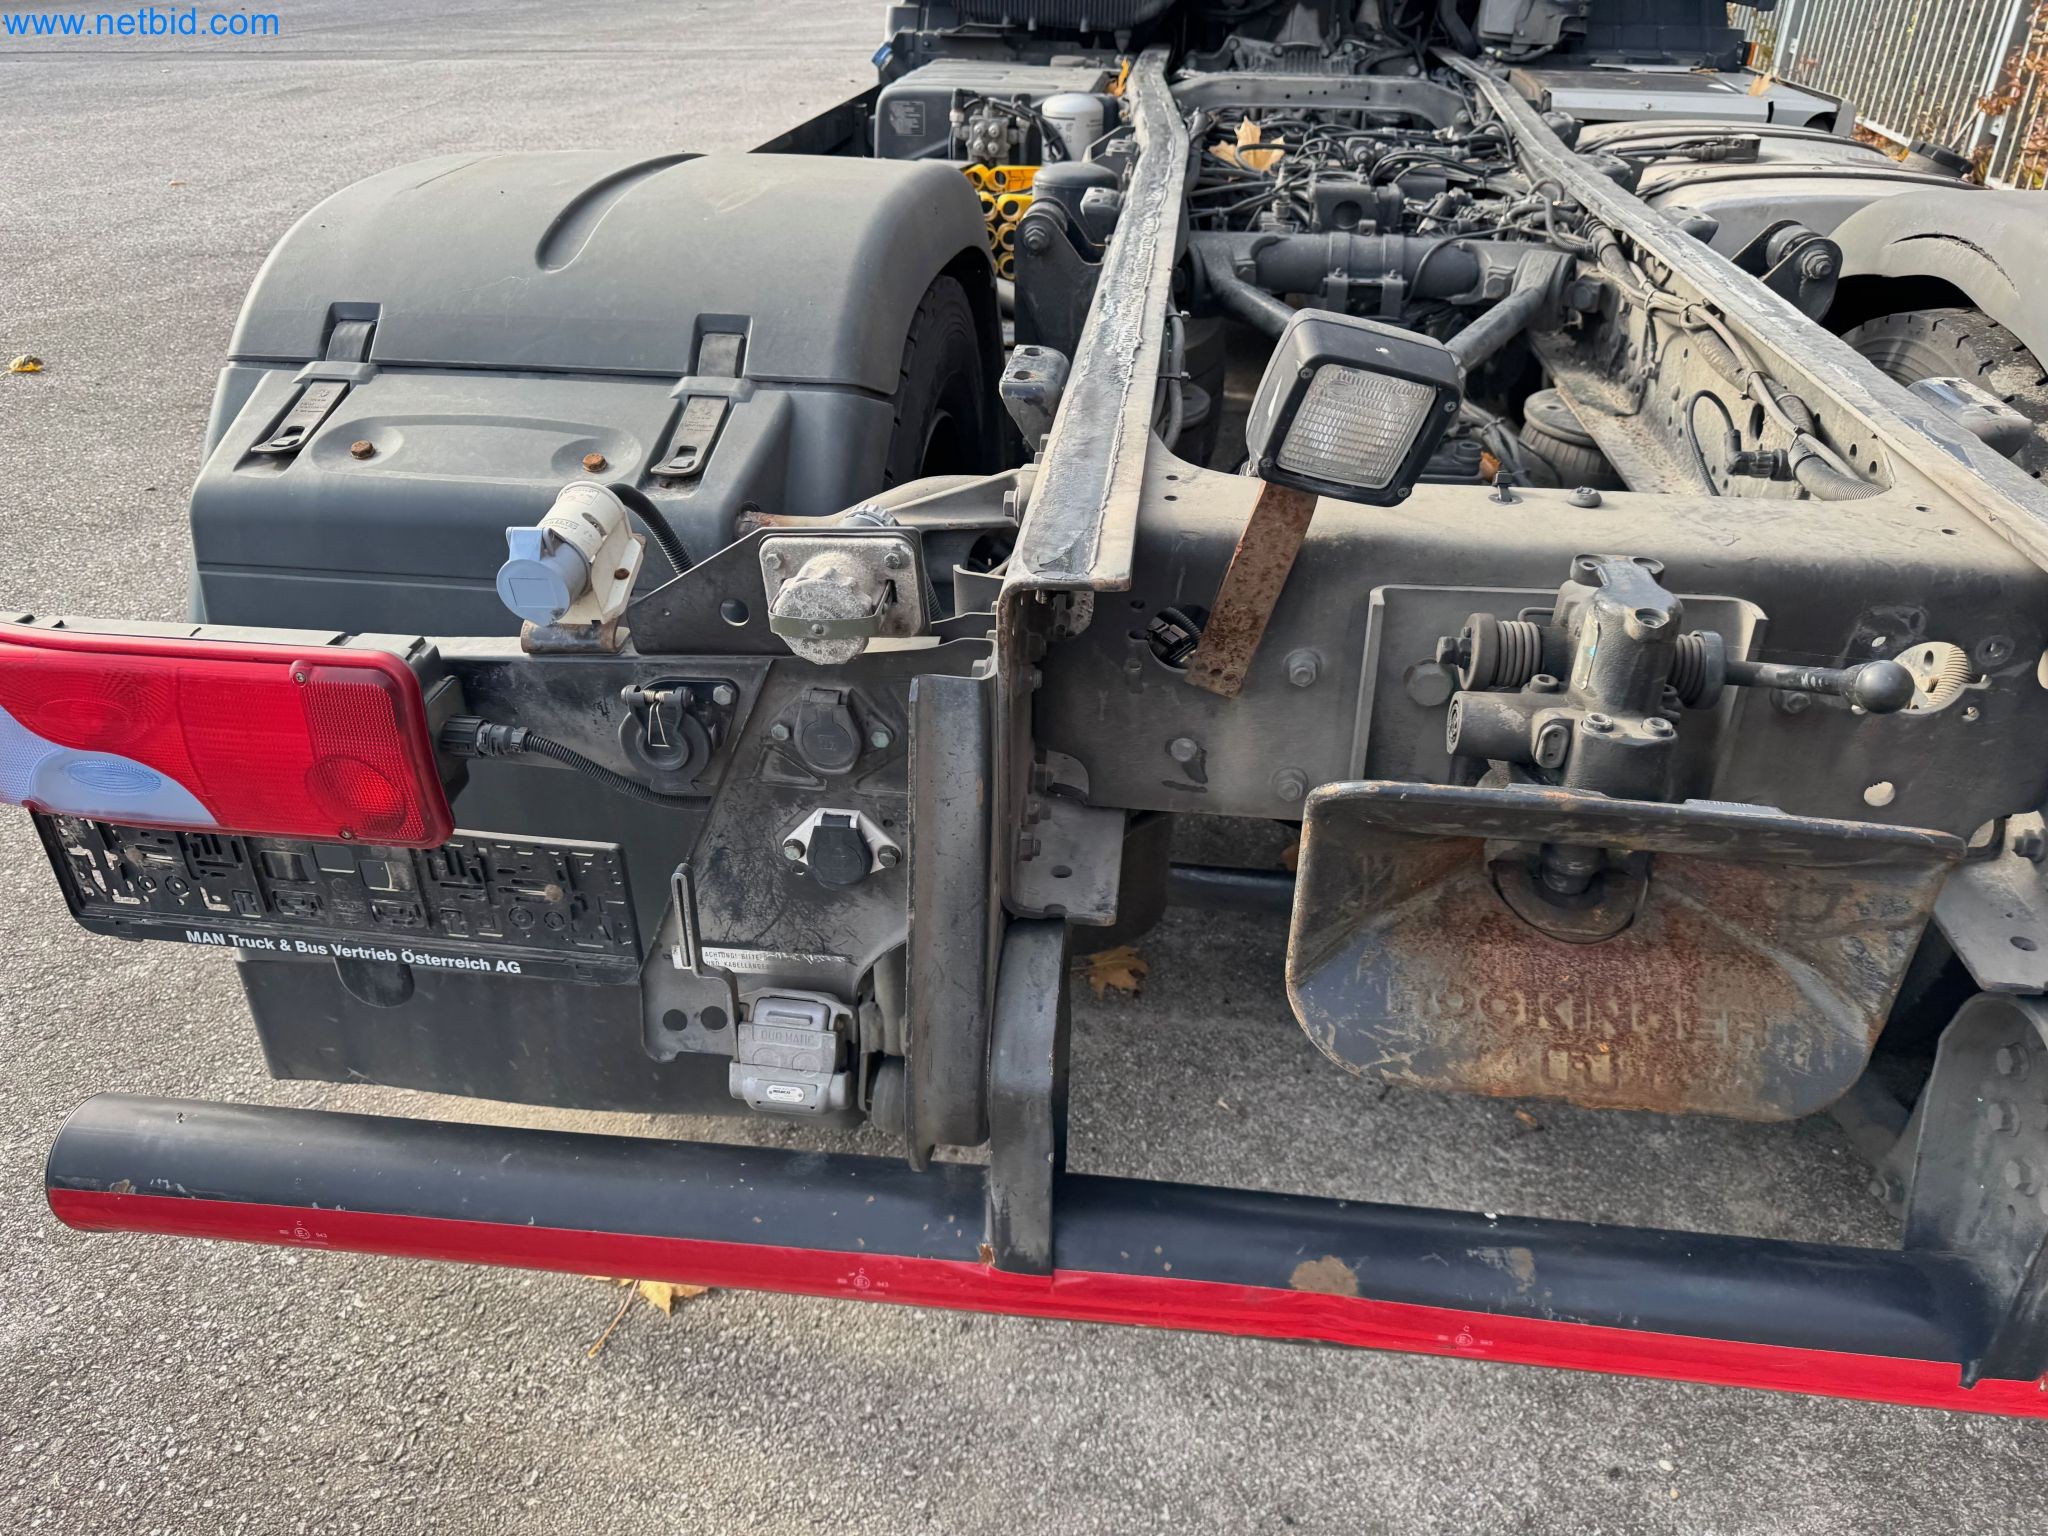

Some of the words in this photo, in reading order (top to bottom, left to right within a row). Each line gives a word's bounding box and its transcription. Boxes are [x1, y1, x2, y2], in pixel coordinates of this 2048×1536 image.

[185, 930, 226, 946] MAN
[228, 934, 275, 950] Truck
[279, 939, 292, 952] &
[294, 940, 329, 956] Bus
[330, 943, 398, 962] Vertrieb
[401, 948, 491, 971] Österreich
[495, 960, 522, 974] AG
